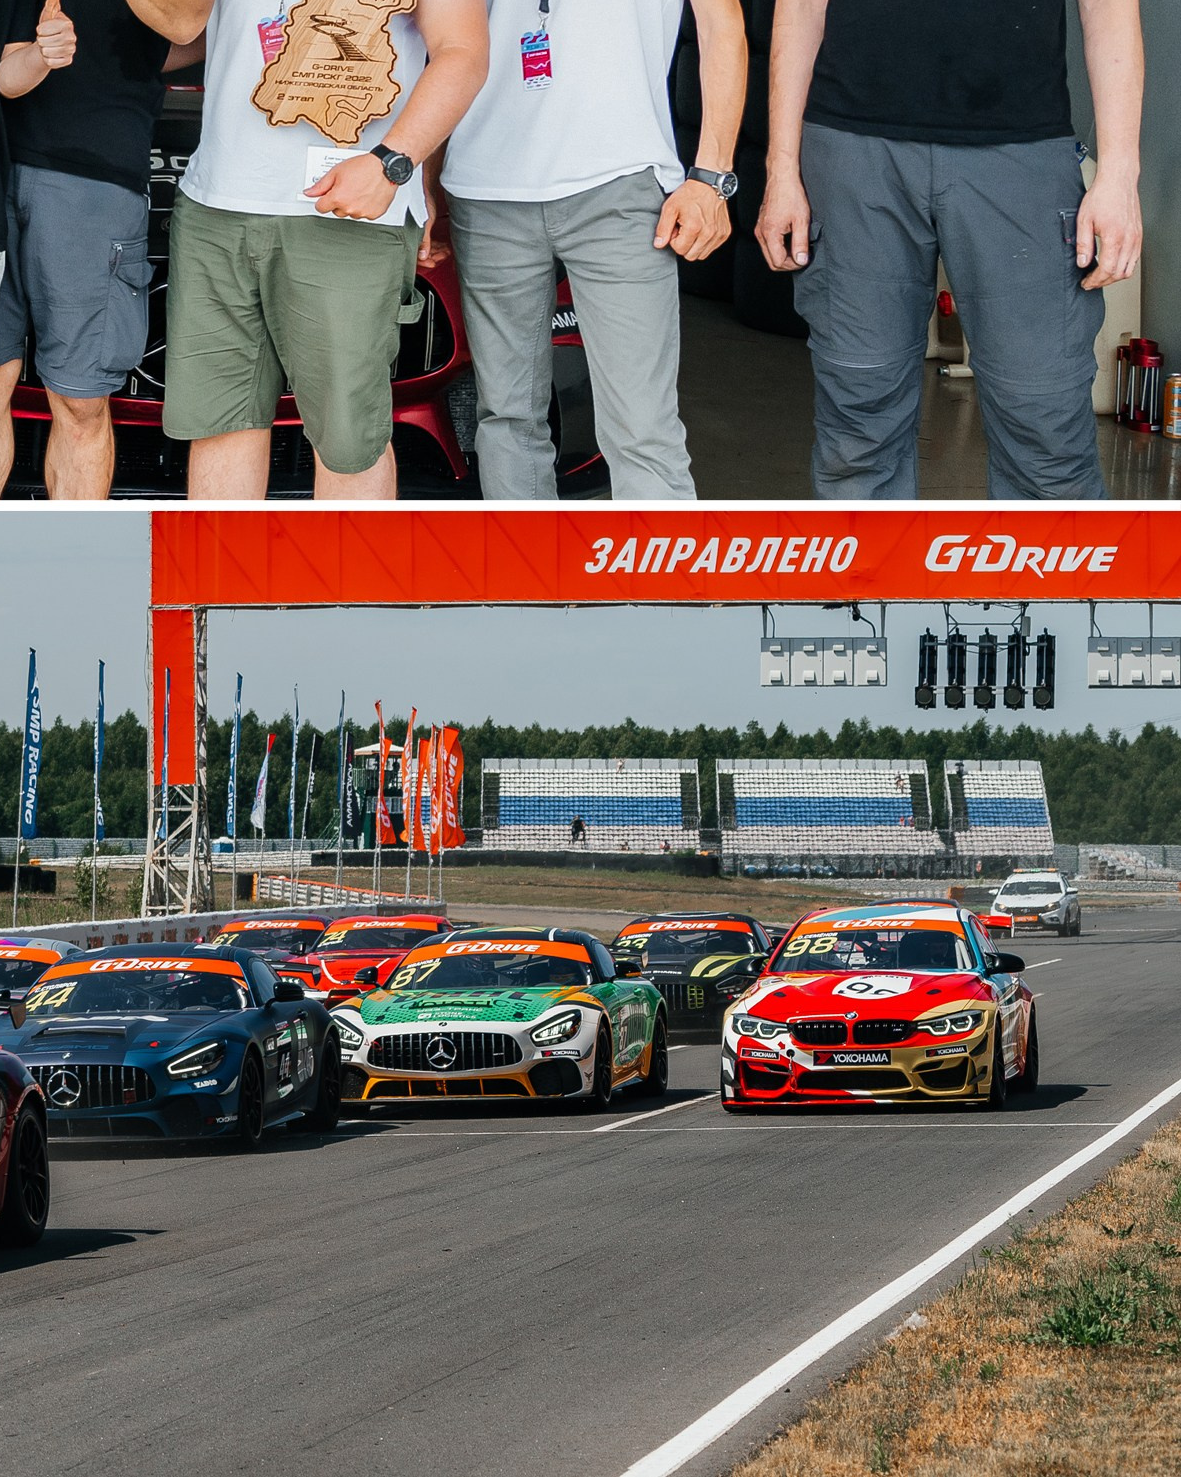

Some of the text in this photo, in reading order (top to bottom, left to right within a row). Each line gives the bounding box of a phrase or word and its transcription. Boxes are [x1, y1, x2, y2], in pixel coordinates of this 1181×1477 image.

[311, 63, 355, 73] G-DRIVE
[316, 73, 342, 81] РСКГ
[344, 75, 372, 83] 2022
[274, 79, 384, 92] НИЖЕГОРОДСКАЯ ОБЛАСТЬ
[276, 92, 286, 101] 2
[584, 535, 859, 575] ЗАПРАВЛЕНО
[924, 534, 1119, 579] G-DRIVE
[24, 745, 39, 824] RACING
[832, 919, 916, 929] G-DRIVE
[446, 940, 540, 955] G-DRIVE
[783, 936, 838, 958] 98
[90, 958, 193, 971] G-DRIVE
[390, 961, 442, 990] 87
[25, 987, 75, 1013] 44
[751, 1050, 777, 1059] YOKOHAMA
[833, 1053, 889, 1063] YOKOHAMA
[936, 1047, 965, 1056] YOKOHAMA
